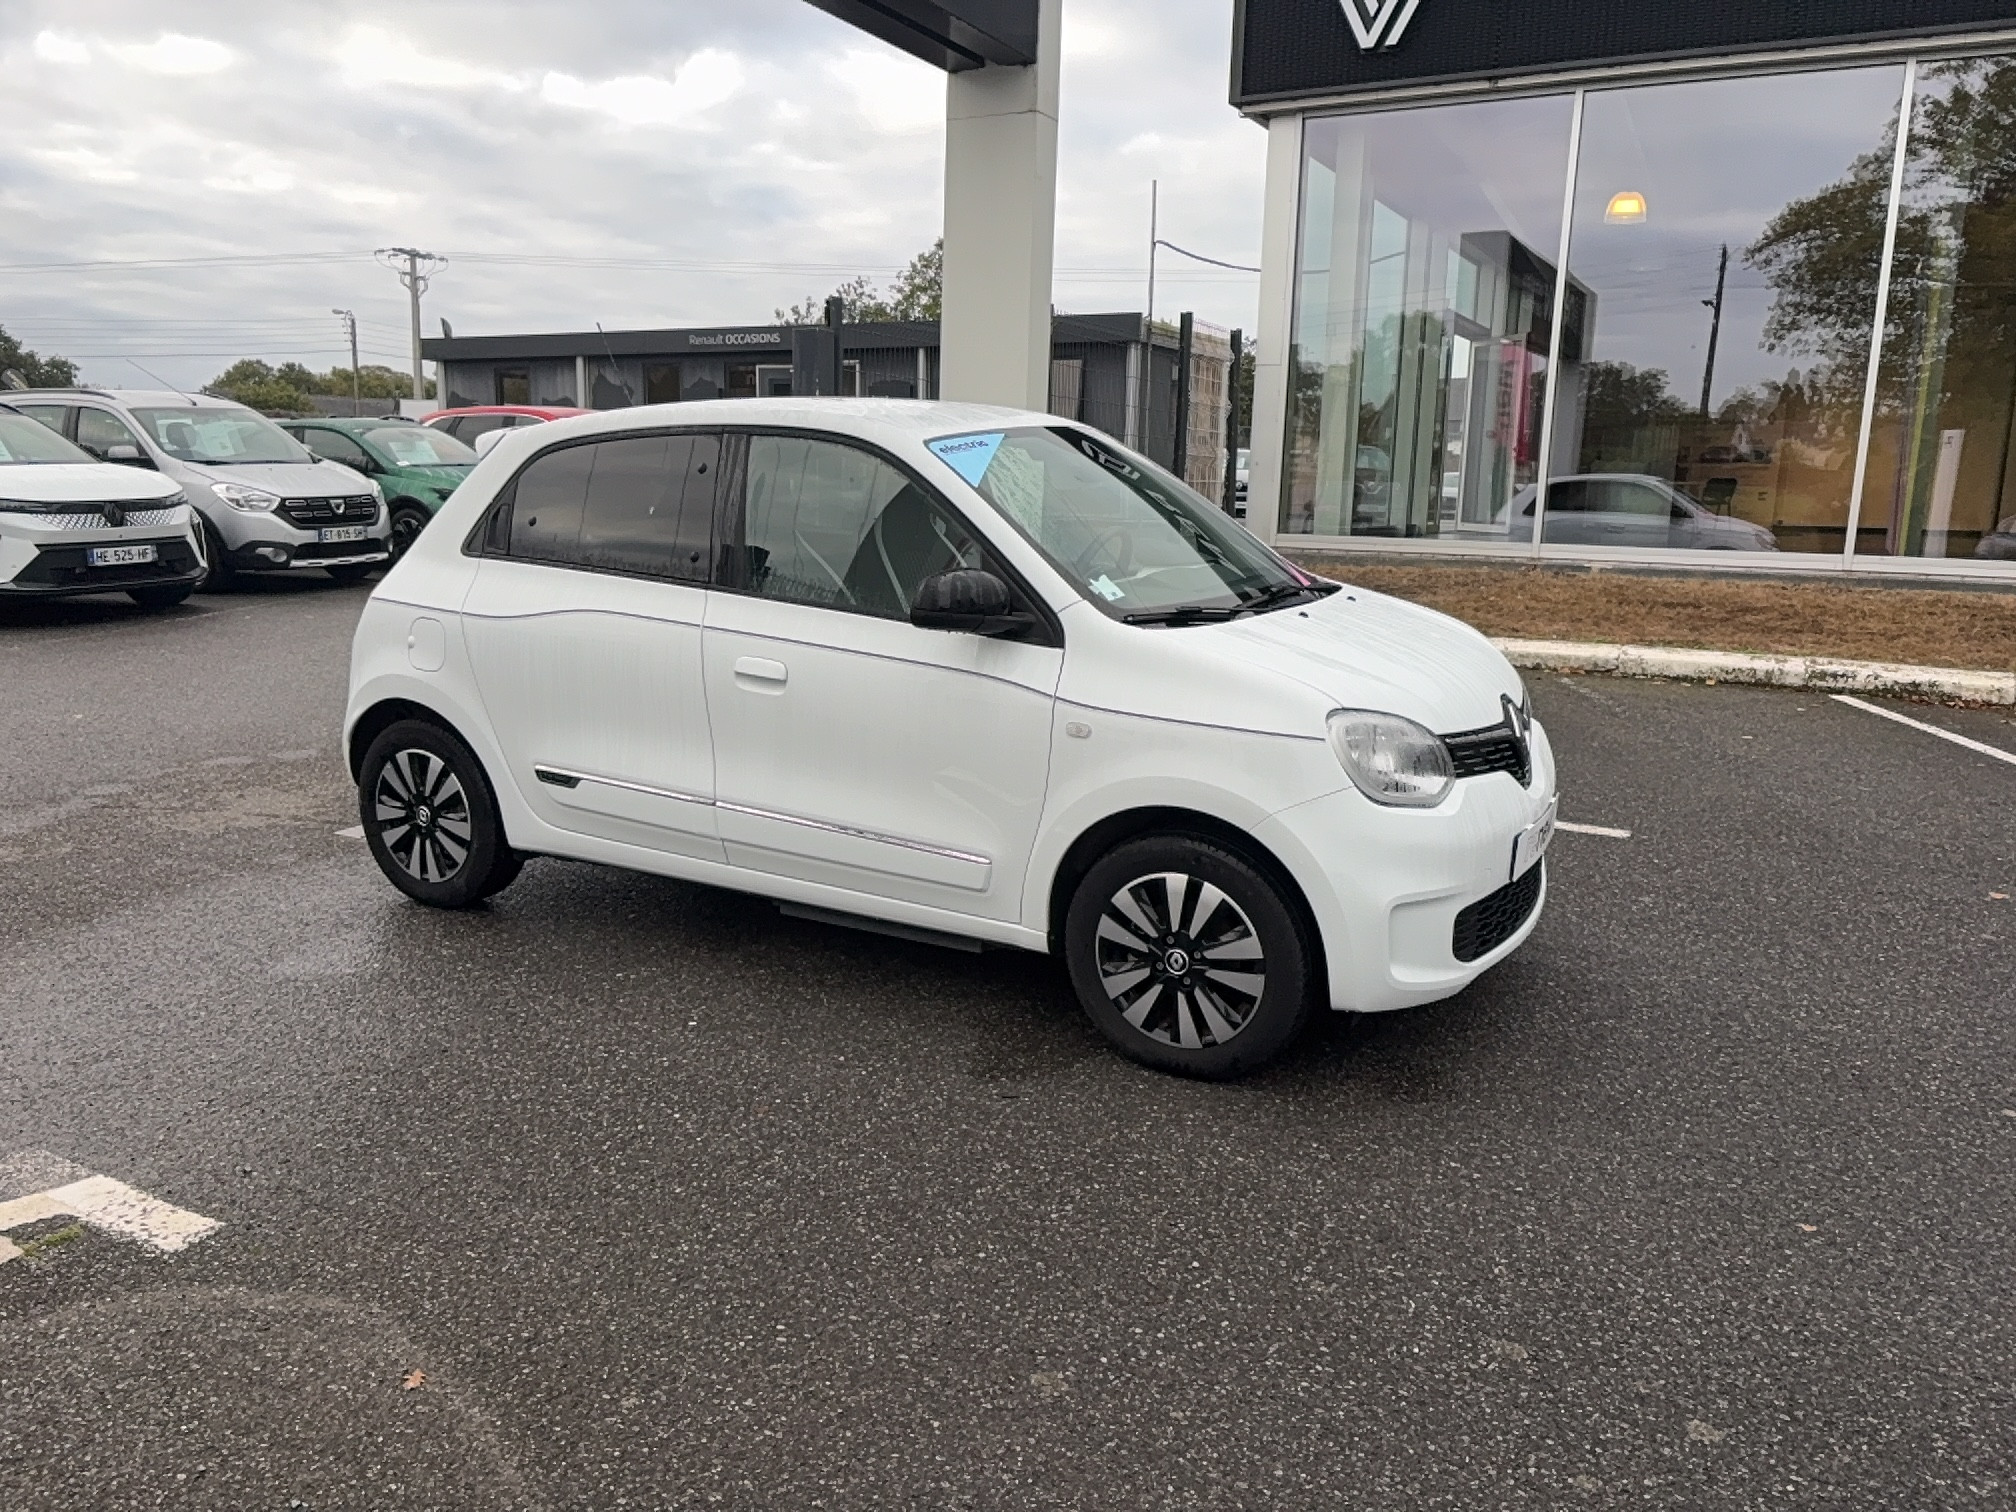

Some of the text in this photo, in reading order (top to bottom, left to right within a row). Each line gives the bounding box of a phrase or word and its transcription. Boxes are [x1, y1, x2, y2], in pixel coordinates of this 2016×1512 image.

[689, 333, 781, 345] Renault OCCASIONS
[939, 439, 989, 454] electric
